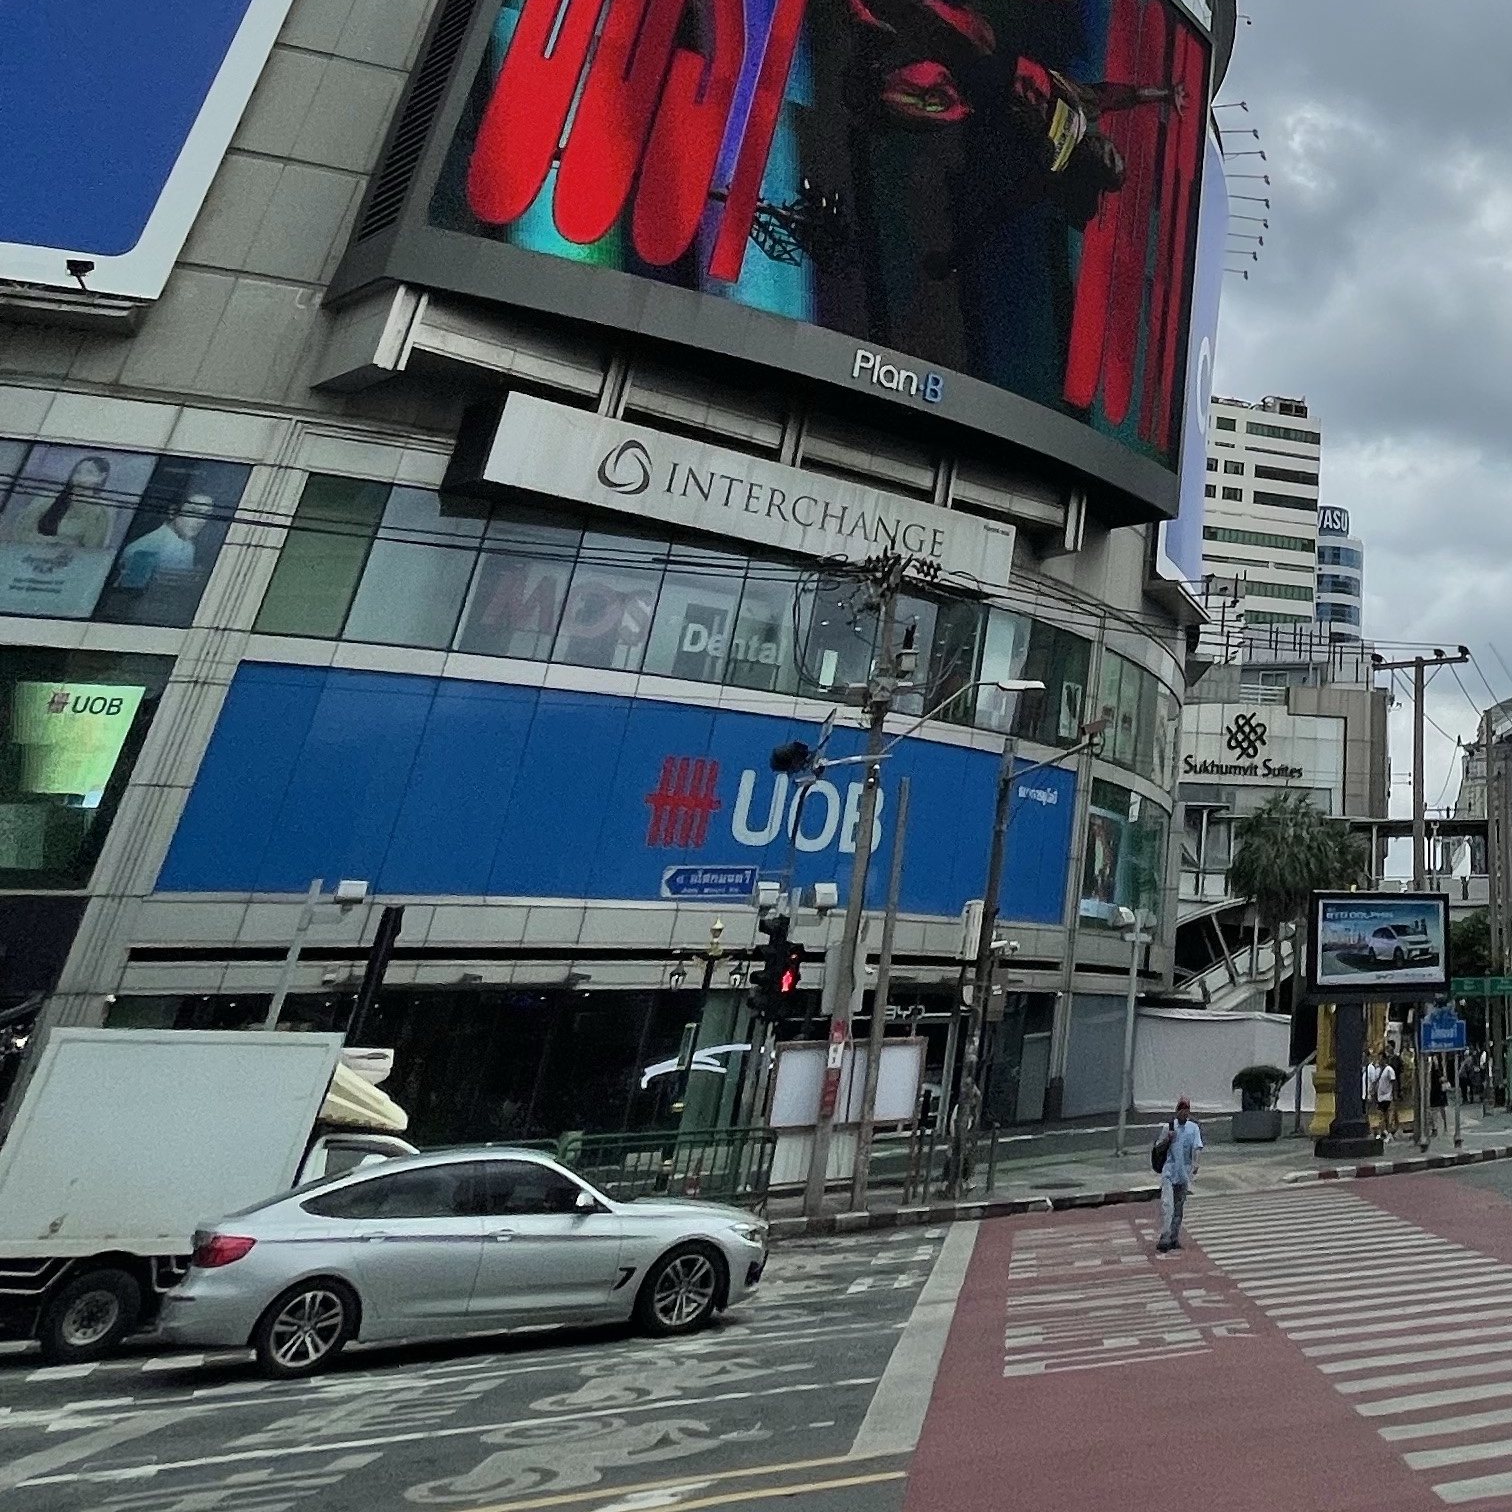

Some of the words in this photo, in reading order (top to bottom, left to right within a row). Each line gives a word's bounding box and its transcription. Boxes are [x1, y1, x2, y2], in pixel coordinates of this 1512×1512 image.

[663, 461, 945, 558] INTERCHANGE
[71, 695, 124, 716] UOB
[1183, 754, 1259, 776] Sukhumvit
[1262, 758, 1304, 778] Suites
[731, 769, 884, 854] UOB
